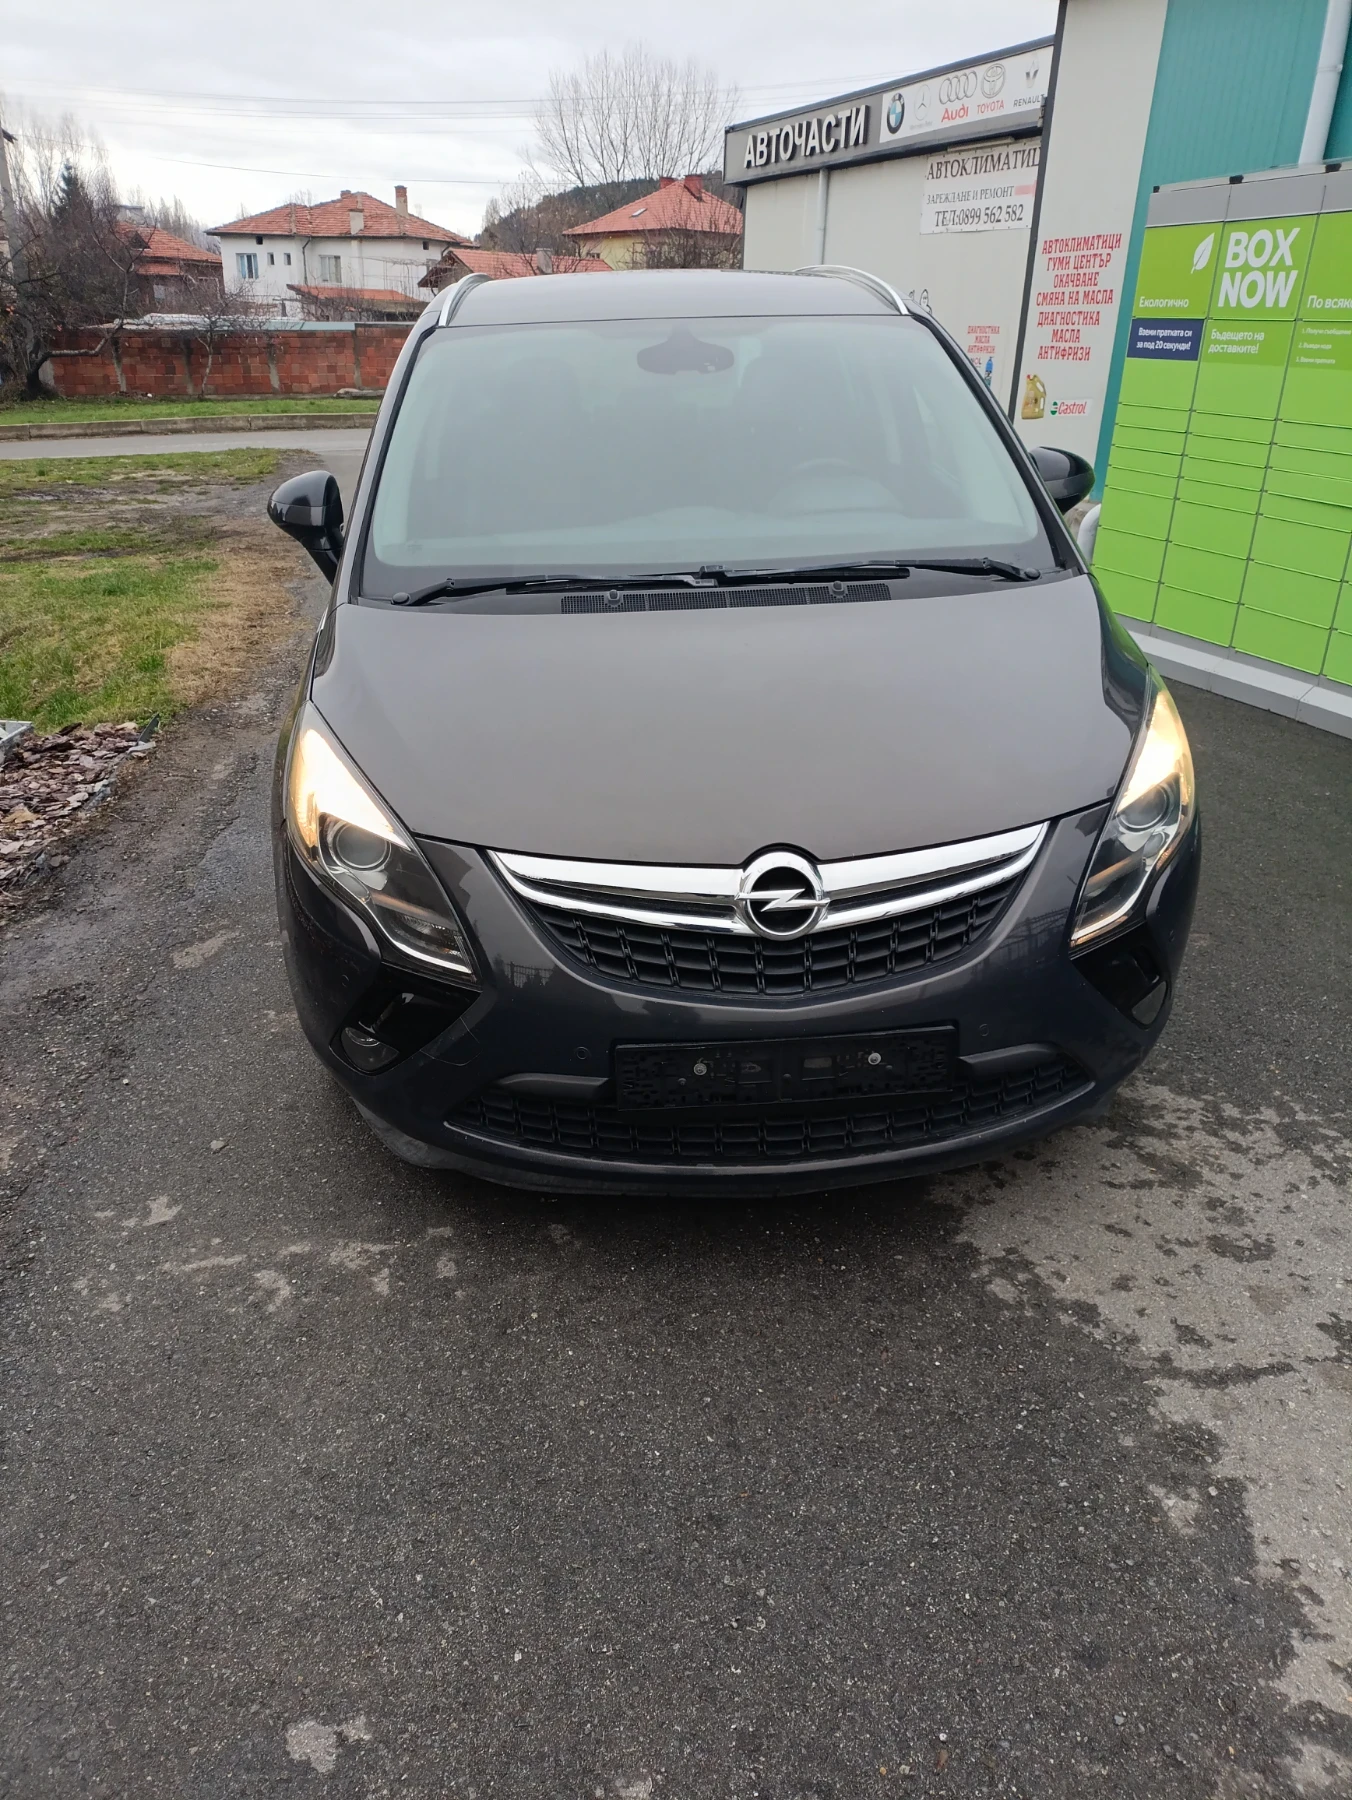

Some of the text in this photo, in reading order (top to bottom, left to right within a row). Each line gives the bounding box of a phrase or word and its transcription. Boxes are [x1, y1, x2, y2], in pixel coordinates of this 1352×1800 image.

[941, 104, 969, 122] Audi
[977, 100, 1005, 115] TOYOTA
[744, 105, 868, 168] АВТОЧАСТИ
[926, 186, 1015, 205] ЗАРЕЖДАНЕ И РЕМОНТ
[935, 204, 1024, 227] ТЕЛ:0899 562 582
[1042, 233, 1122, 254] АВТОКЛИМАТИЦИ
[1224, 228, 1301, 268] BOX
[1046, 253, 1111, 271] ГУМИ ЦЕНТЪР
[1053, 272, 1099, 288] ОКАЧВАНЕ
[1217, 270, 1298, 308] NOW
[1036, 289, 1114, 306] СМЯНА НА МАСЛА
[1139, 296, 1189, 308] Екологично
[1307, 295, 1323, 308] По
[1037, 311, 1100, 327] ДИАГНОСТИКА
[1051, 329, 1080, 343] МАСЛА
[1138, 327, 1157, 336] Вземи
[1157, 329, 1183, 338] пратката
[1211, 329, 1264, 341] Бъдещето на
[1037, 346, 1091, 361] АНТИФРИЗИ
[1143, 342, 1155, 350] под
[1163, 342, 1191, 351] секунди!
[1208, 343, 1259, 354] доставките!
[1058, 401, 1087, 414] Castrol
